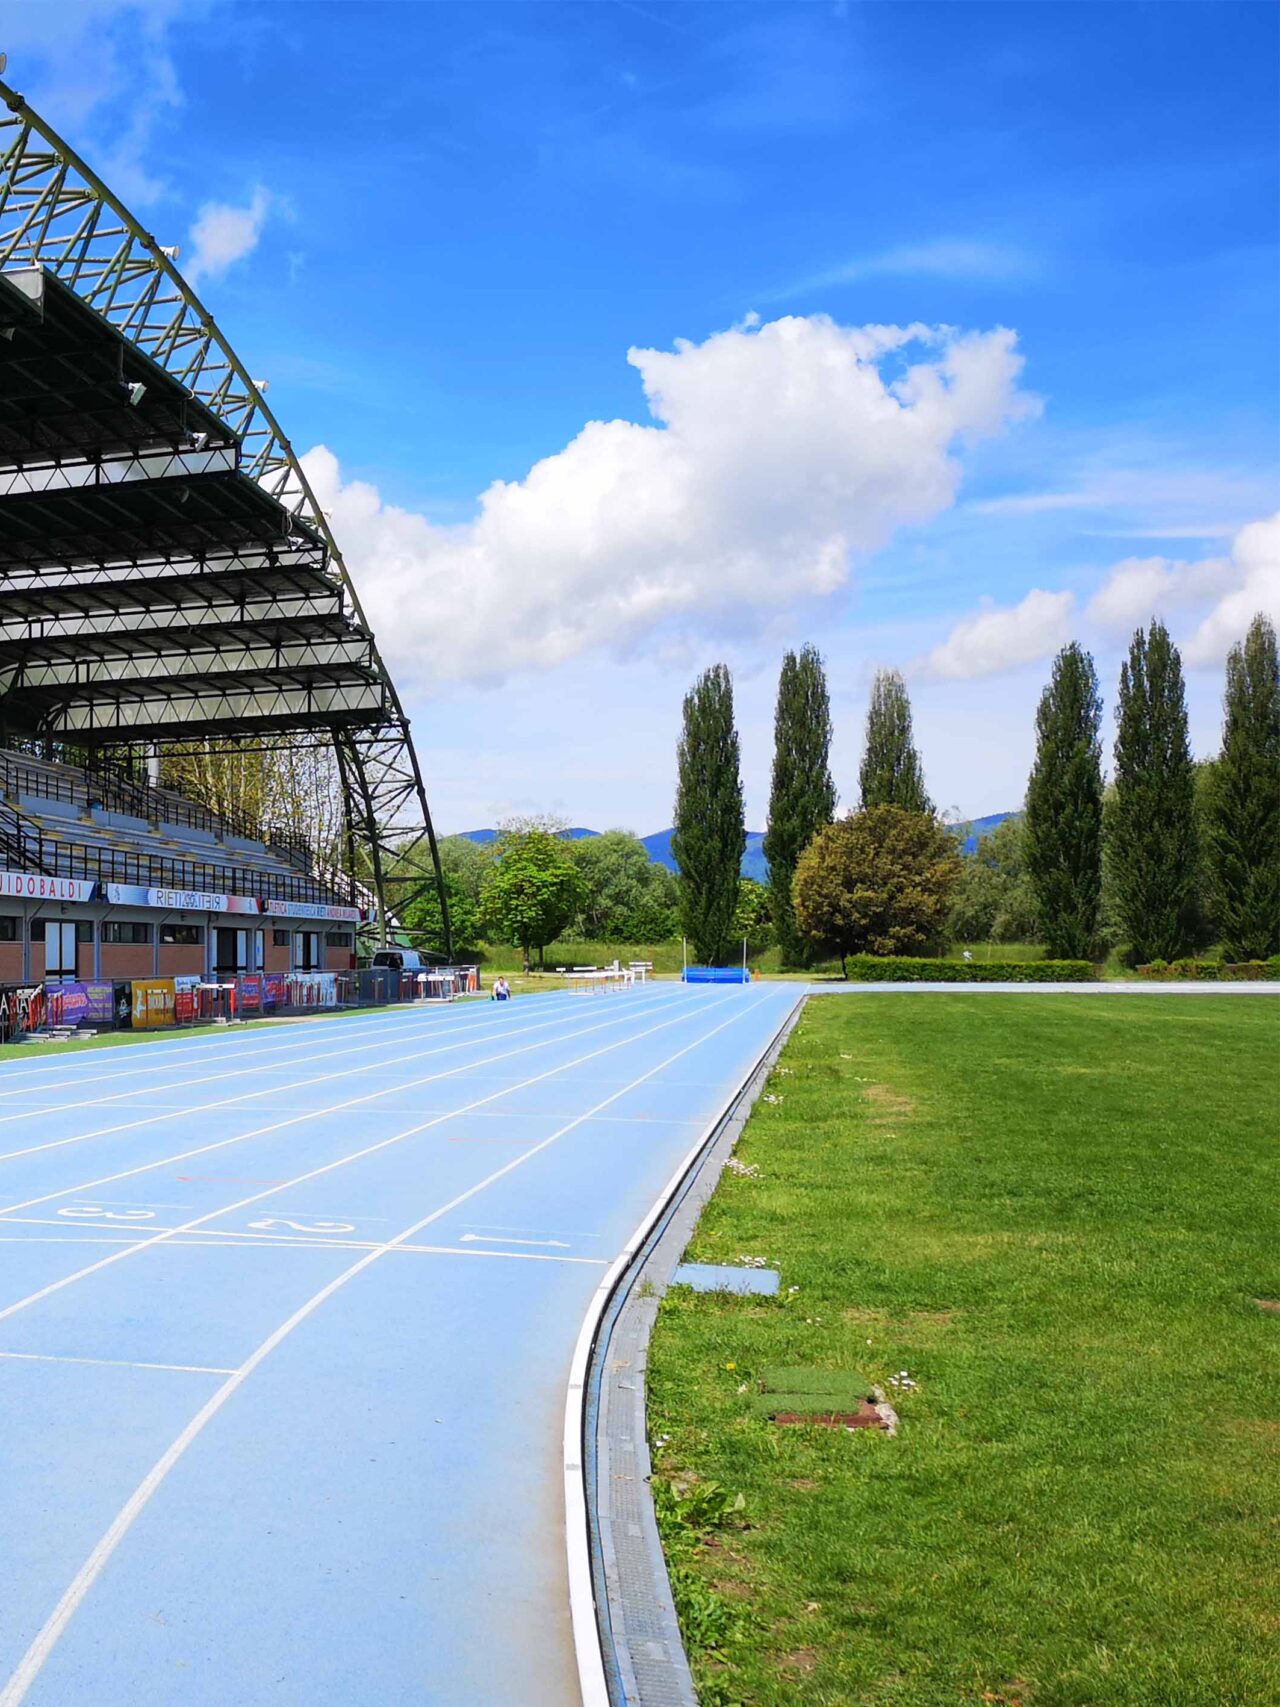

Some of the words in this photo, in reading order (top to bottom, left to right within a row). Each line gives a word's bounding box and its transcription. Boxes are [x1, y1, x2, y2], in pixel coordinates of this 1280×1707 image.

[157, 890, 181, 907] RIETI
[57, 1207, 156, 1221] 3
[247, 1218, 356, 1233] 2
[459, 1233, 571, 1247] 1
